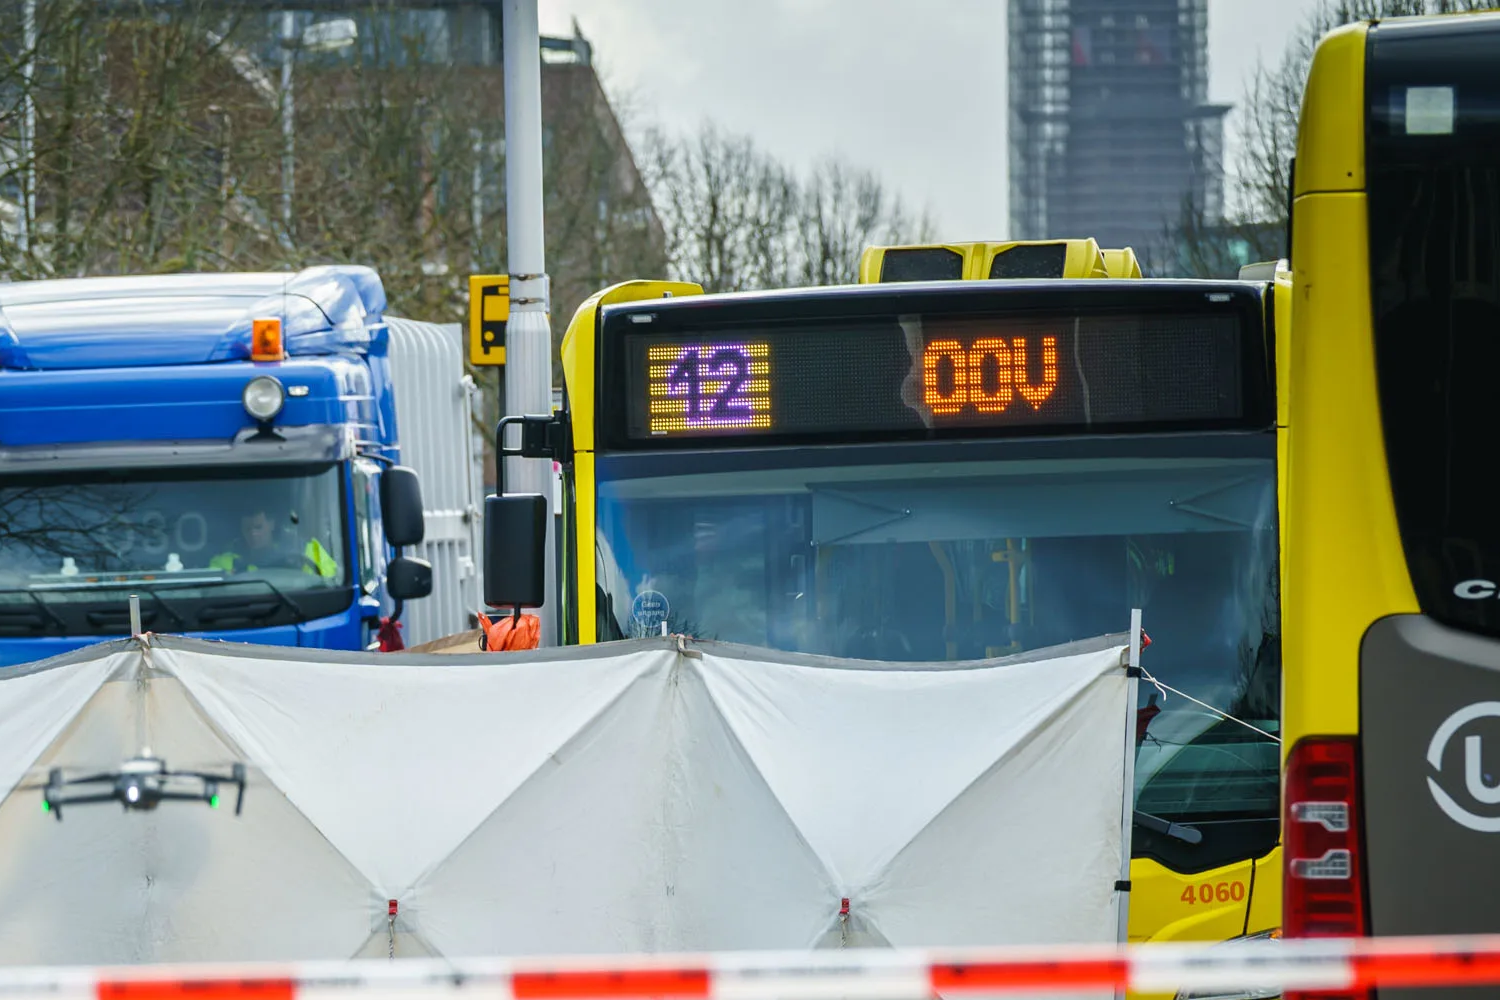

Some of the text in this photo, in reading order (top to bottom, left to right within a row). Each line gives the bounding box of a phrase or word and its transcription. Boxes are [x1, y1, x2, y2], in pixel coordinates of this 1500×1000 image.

[668, 345, 753, 426] 12
[1453, 579, 1500, 599] C
[1180, 881, 1245, 905] 4060
